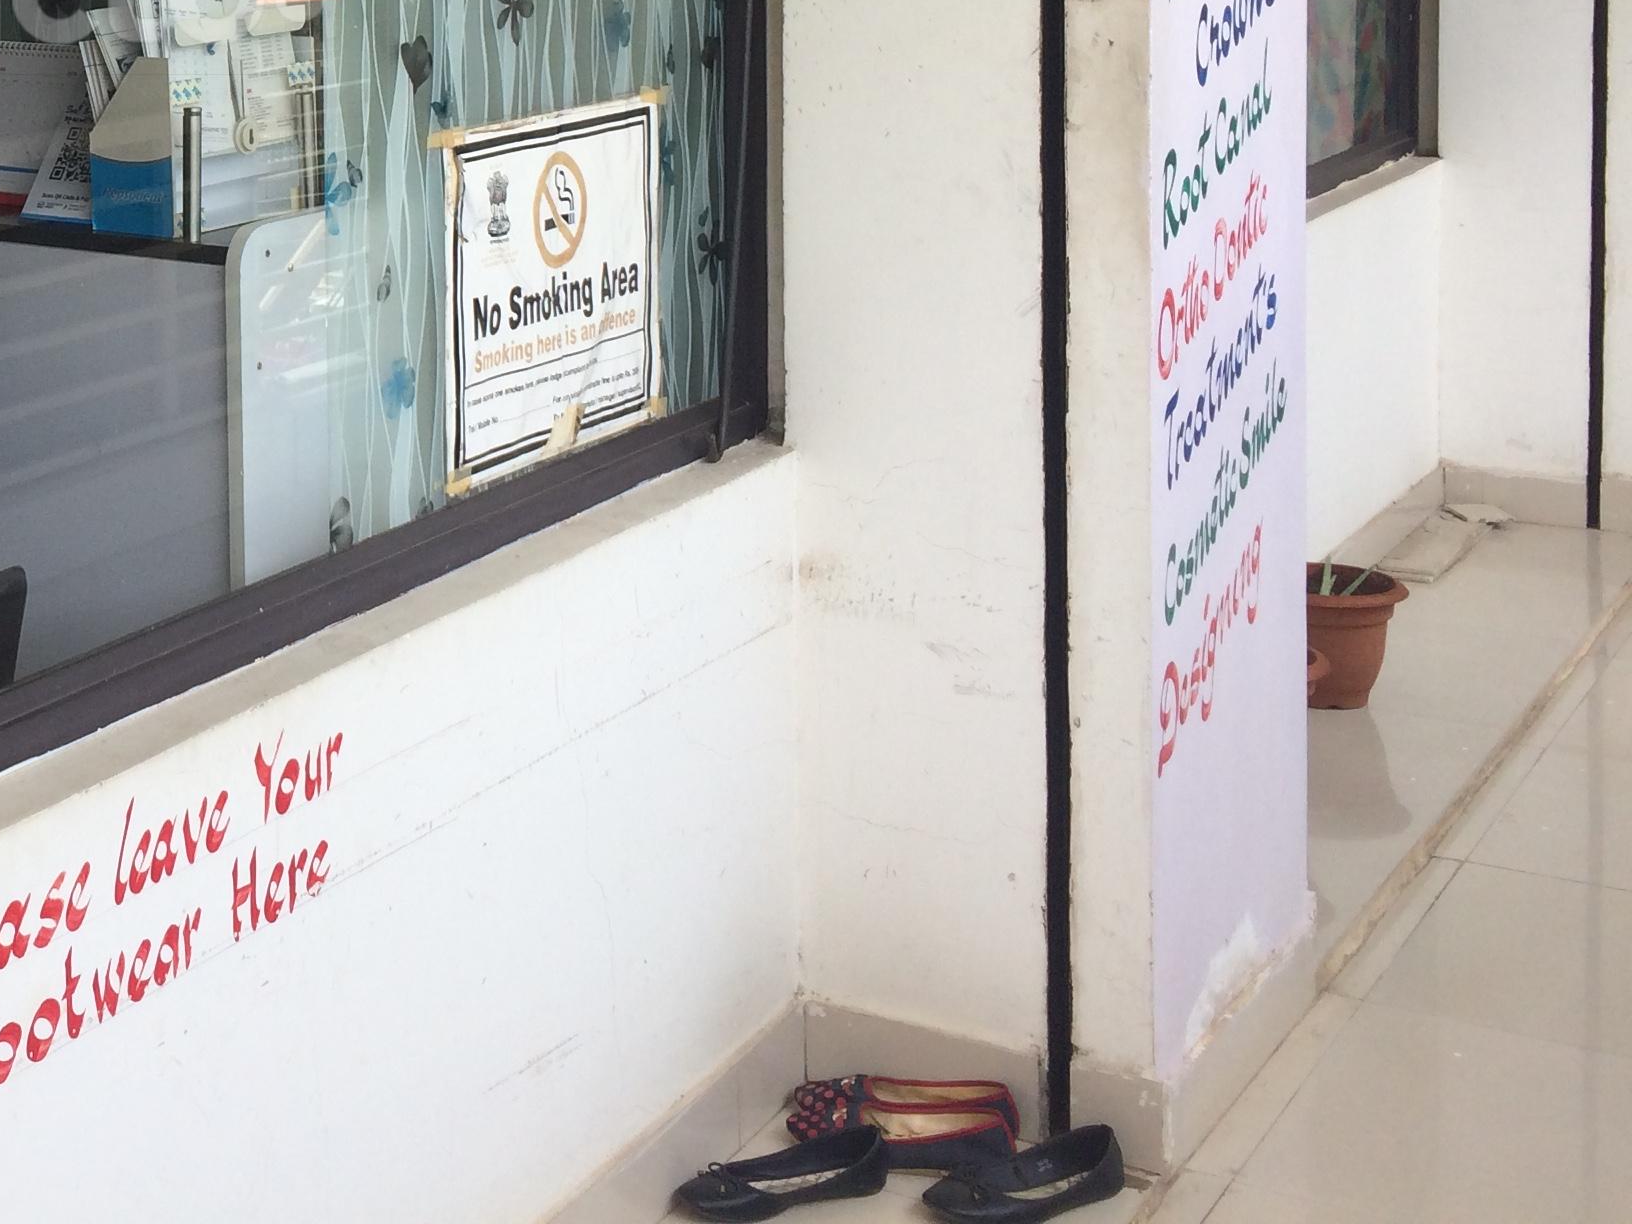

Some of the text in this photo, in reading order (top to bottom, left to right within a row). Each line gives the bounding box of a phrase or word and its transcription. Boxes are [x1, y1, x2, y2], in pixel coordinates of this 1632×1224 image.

[1163, 37, 1272, 250] Root Canal
[473, 262, 639, 342] No Smoking Area
[474, 340, 534, 373] Smoking
[536, 334, 562, 355] here
[565, 325, 577, 345] is
[581, 324, 596, 342] an
[1158, 170, 1268, 380] Ortho Dontic
[1164, 357, 1288, 626] Cosmetic Smile
[1158, 516, 1264, 778] Designing
[114, 790, 231, 906] leave
[254, 729, 343, 824] Your
[231, 840, 331, 942] Here
